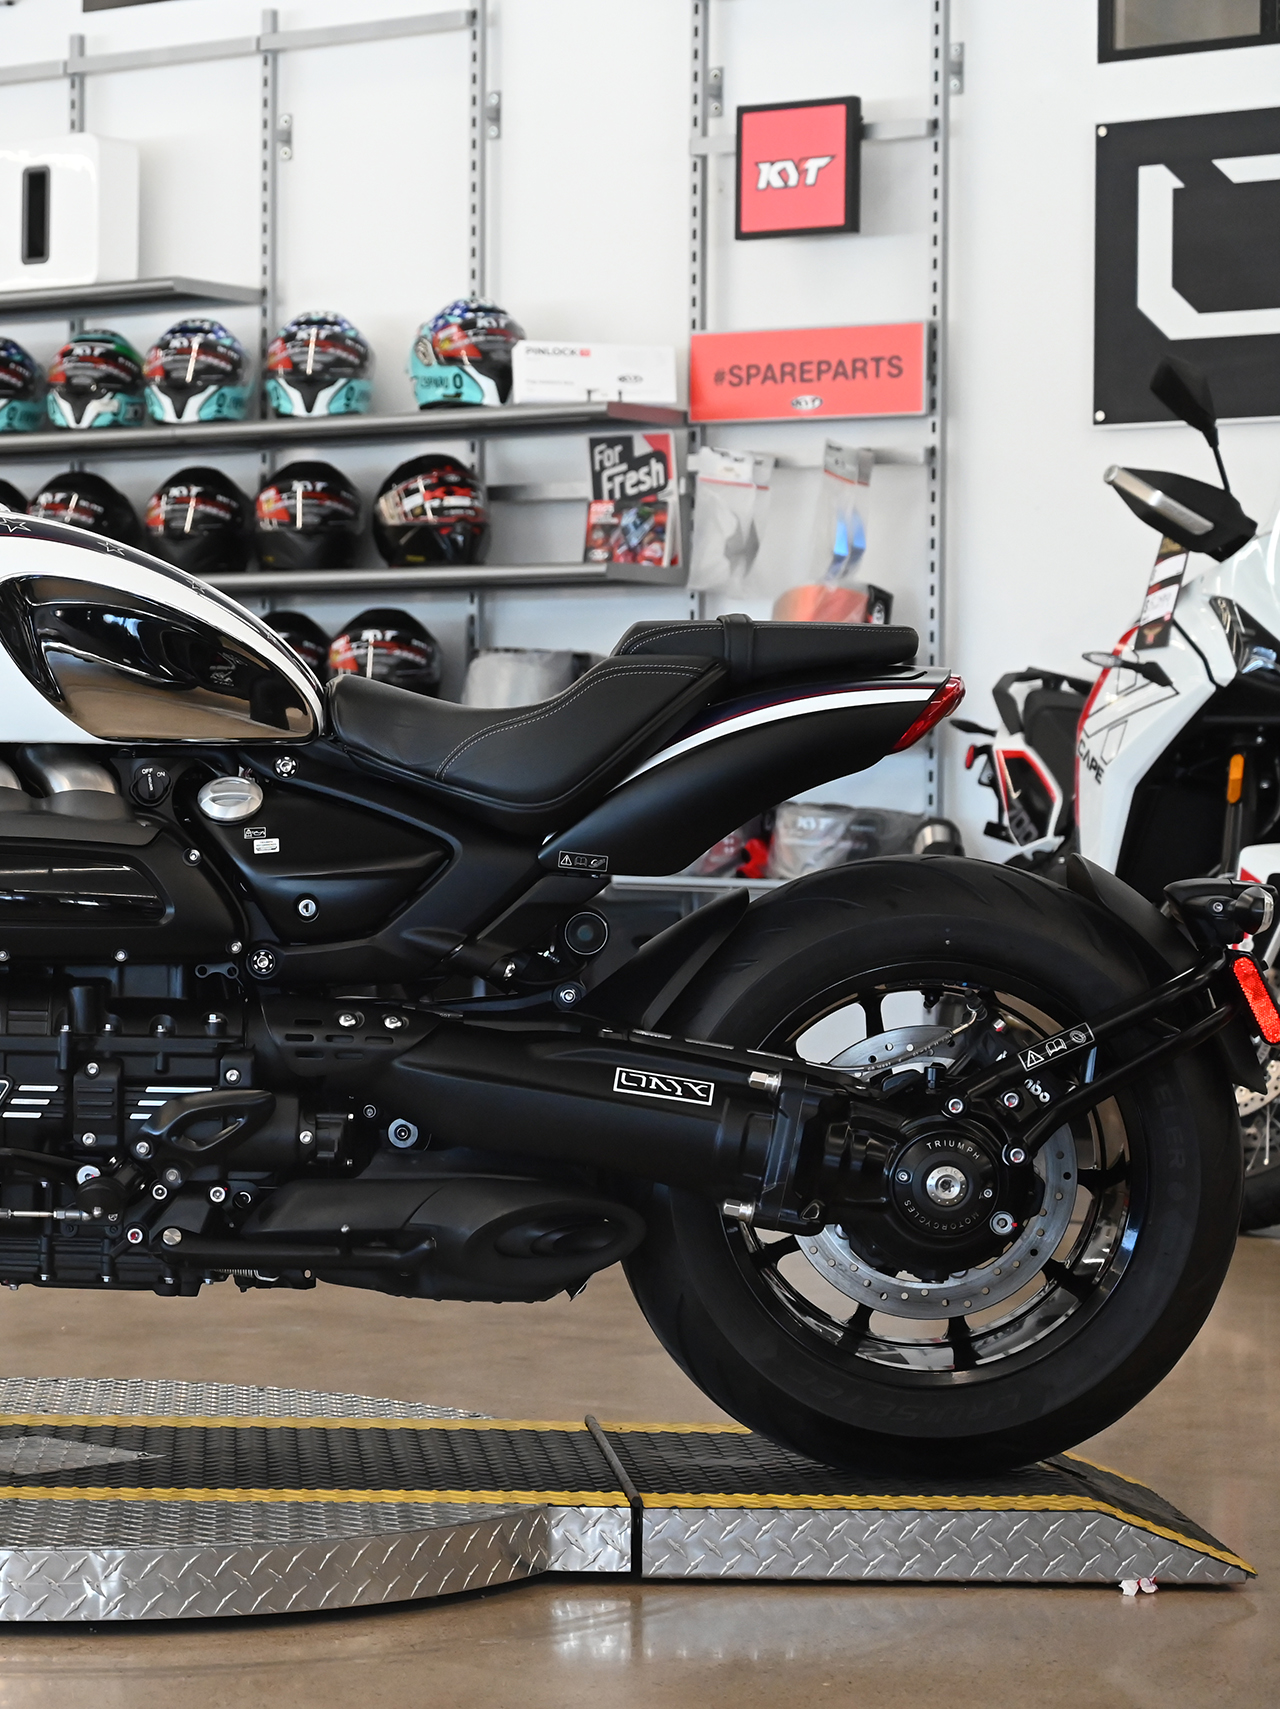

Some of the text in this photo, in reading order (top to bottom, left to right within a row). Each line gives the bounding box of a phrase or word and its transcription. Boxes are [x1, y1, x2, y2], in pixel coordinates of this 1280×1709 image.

[755, 154, 836, 190] KYT
[526, 346, 578, 357] PINLOCK
[713, 355, 904, 388] #SPAREPARTS
[593, 443, 623, 471] For
[601, 457, 666, 500] Fresh
[620, 1072, 709, 1098] ONYX
[926, 1140, 980, 1160] TRIUMPH
[903, 1199, 980, 1231] MOTORCYCLES
